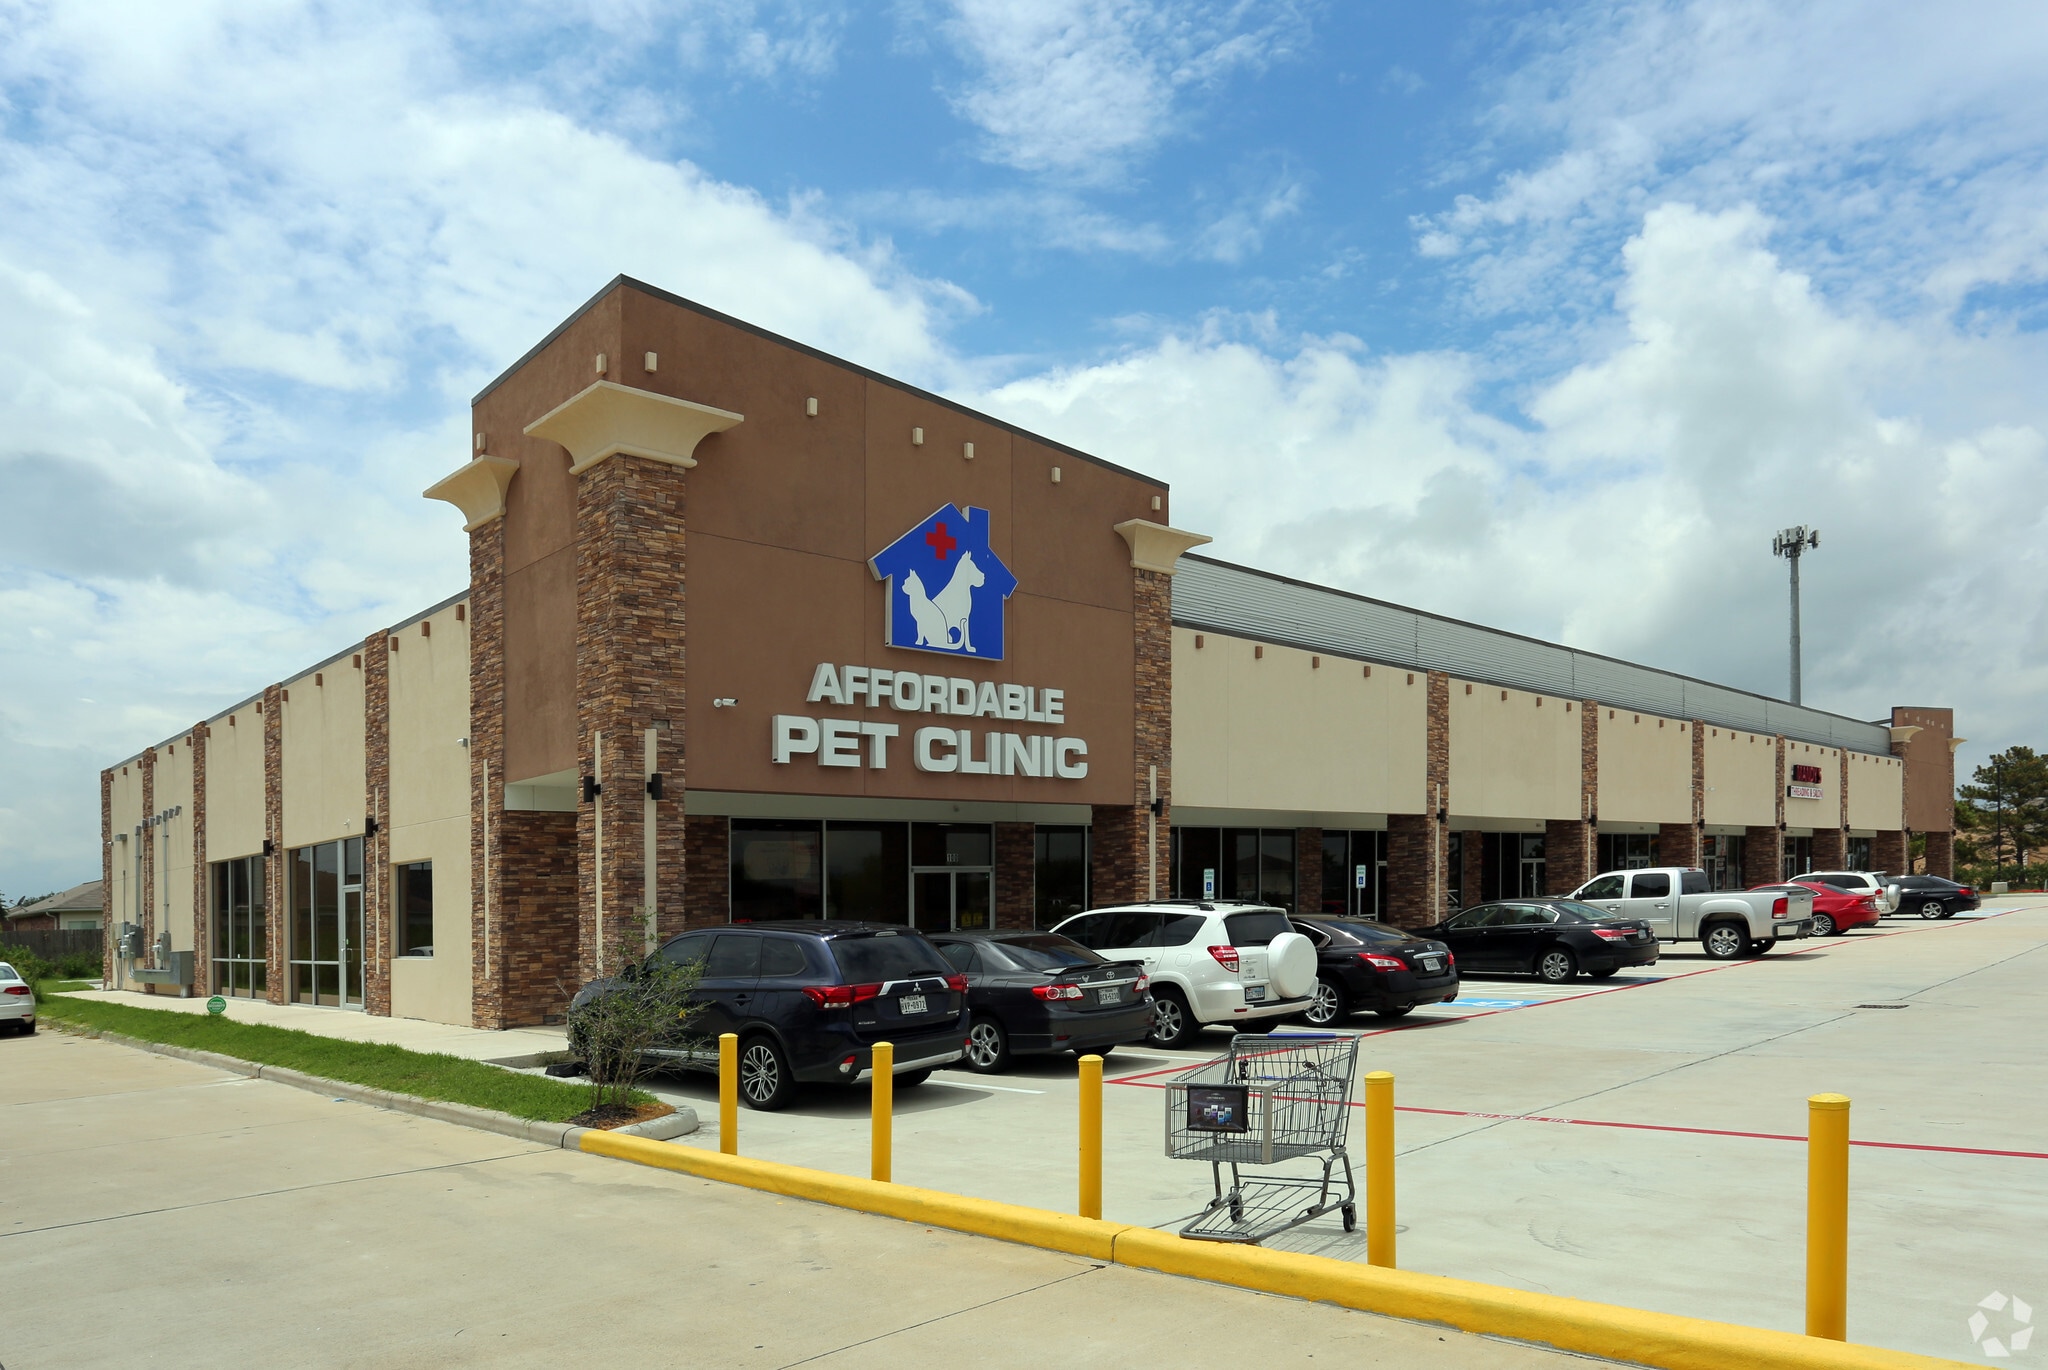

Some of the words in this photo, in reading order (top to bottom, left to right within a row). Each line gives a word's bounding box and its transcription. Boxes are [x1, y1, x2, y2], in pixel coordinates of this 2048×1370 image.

[806, 662, 1065, 724] AFFORDABLE
[771, 714, 899, 769] PET
[913, 726, 1088, 780] CLINIC
